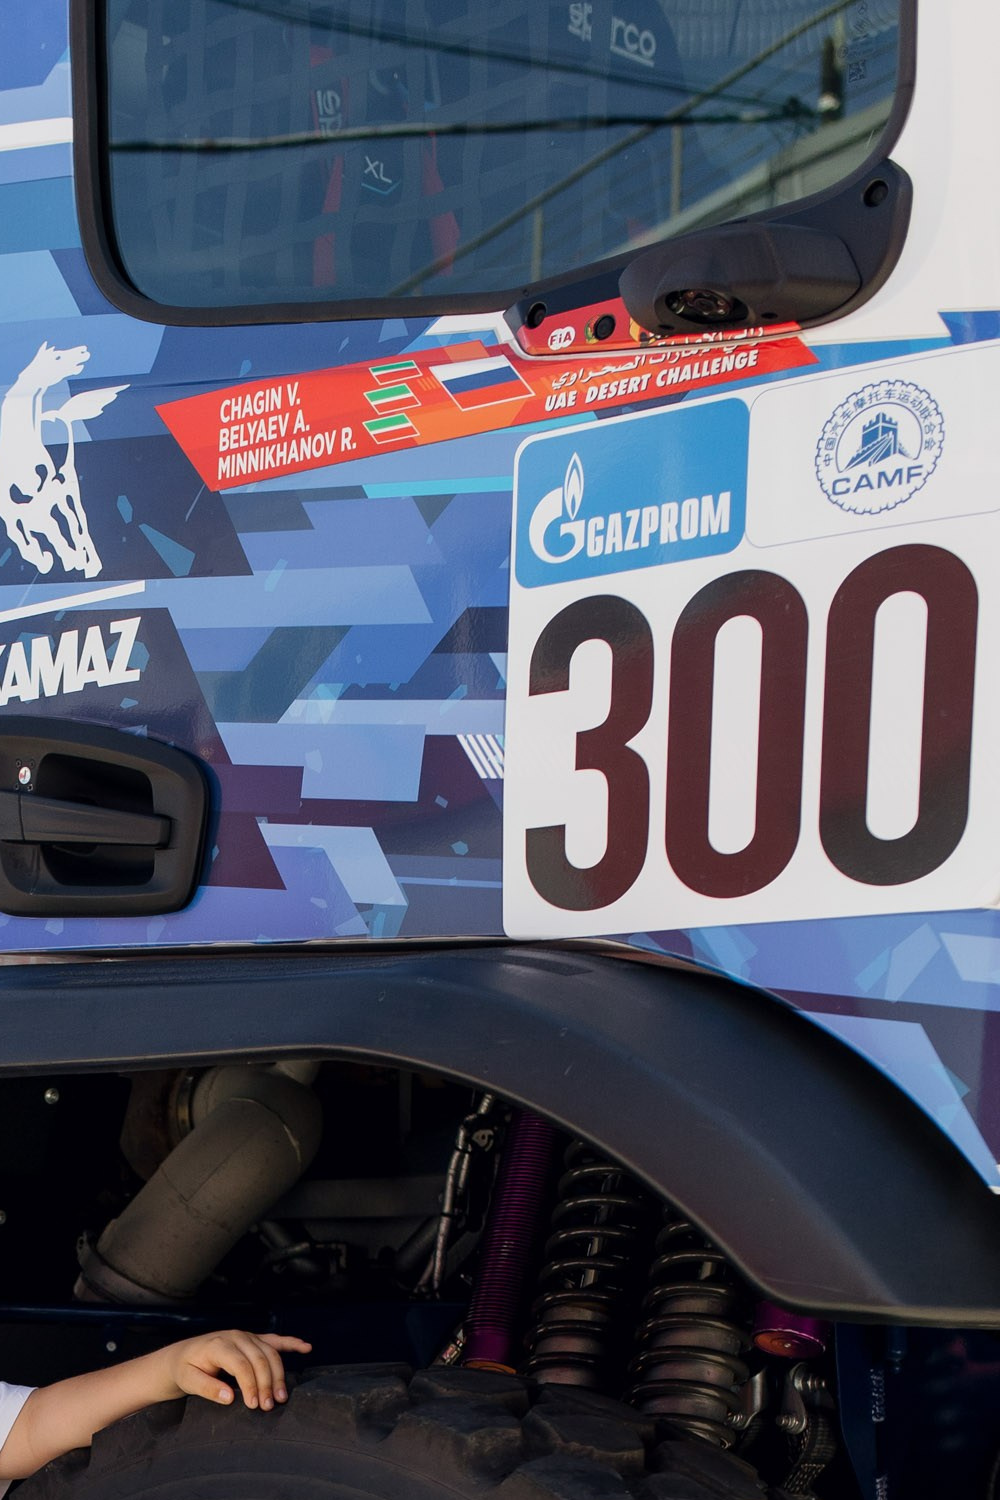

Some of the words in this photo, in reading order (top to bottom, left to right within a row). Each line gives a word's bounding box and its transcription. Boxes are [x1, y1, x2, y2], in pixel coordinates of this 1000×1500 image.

[363, 155, 392, 184] XL
[220, 384, 283, 423] CHAGIN
[285, 381, 301, 406] V.
[544, 390, 576, 412] UAE
[585, 373, 652, 404] DESERT
[656, 350, 759, 387] CHALLENGE
[217, 429, 337, 480] MINNIKHANOV
[340, 426, 357, 452] R.
[219, 412, 289, 452] BELYAEV
[293, 409, 310, 433] A.
[831, 465, 924, 496] CAMF
[586, 491, 731, 558] GAZPROM
[525, 543, 980, 912] 300
